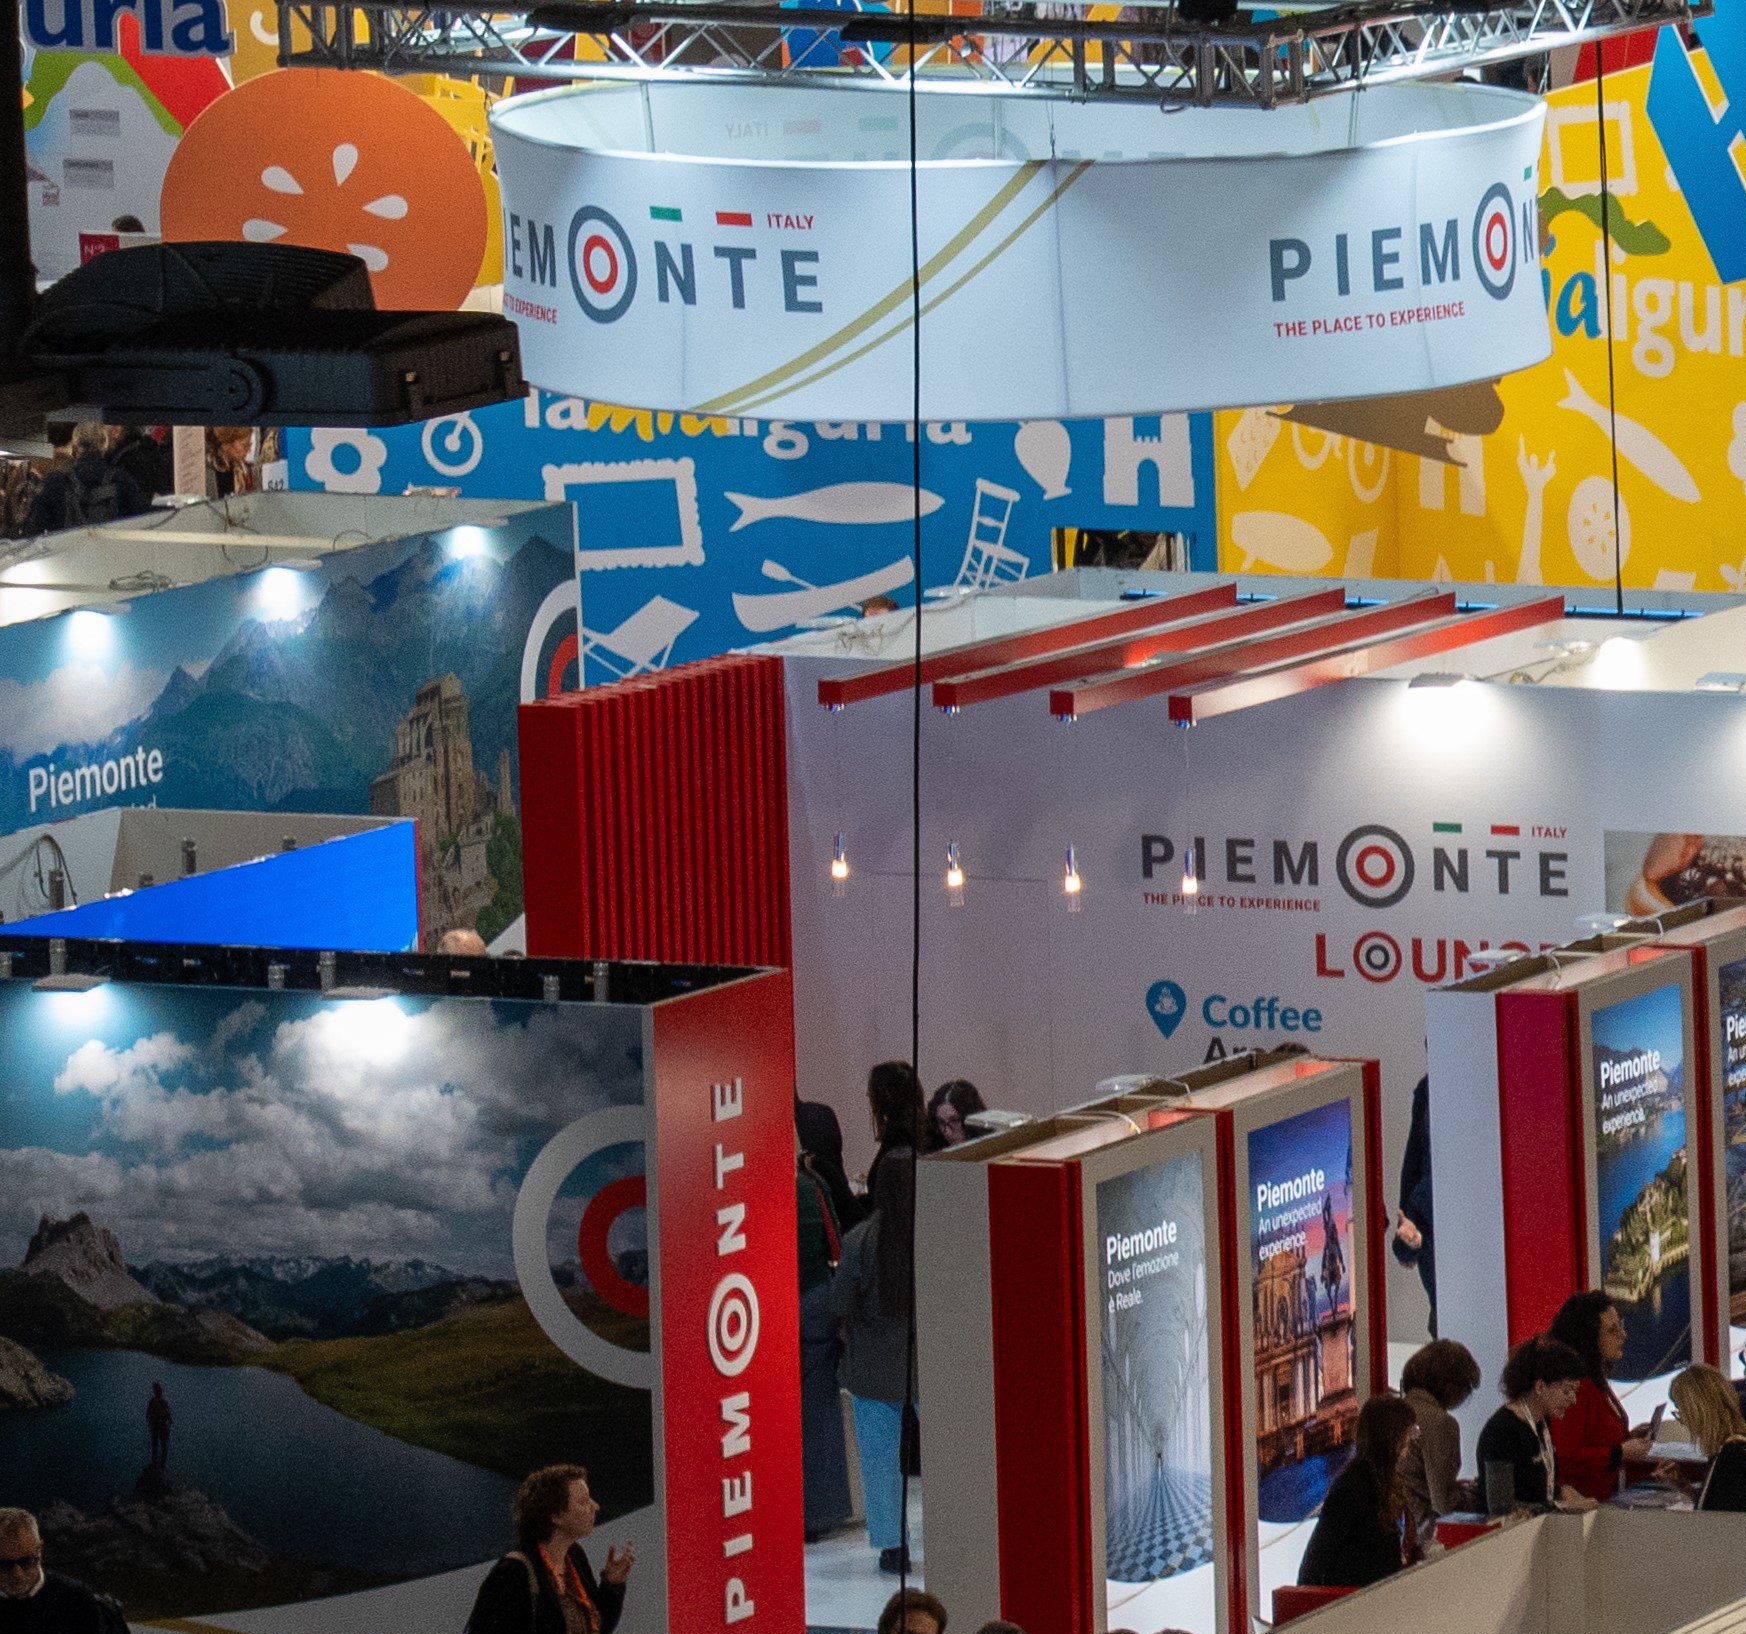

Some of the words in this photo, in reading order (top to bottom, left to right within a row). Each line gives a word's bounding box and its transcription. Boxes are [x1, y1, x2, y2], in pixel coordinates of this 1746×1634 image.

[766, 213, 814, 232] ITALY
[1269, 182, 1535, 302] PIEMON
[504, 205, 823, 324] IEMONTE
[1274, 321, 1308, 338] THE
[1312, 315, 1362, 336] PLACE
[1366, 312, 1386, 329] TO
[1390, 301, 1465, 326] EXPERIENCE
[28, 745, 164, 812] Piemonte
[1530, 825, 1568, 840] ITALY
[1142, 824, 1570, 909] PIEMONTE
[1143, 891, 1168, 905] THE
[1219, 895, 1235, 908] TO
[1240, 896, 1321, 911] EXPERIENCE
[1202, 994, 1323, 1032] Coffee
[1600, 1048, 1661, 1089] Piemonte
[1258, 1168, 1325, 1213] Piemonte
[1259, 1218, 1272, 1236] An
[1273, 1196, 1323, 1228] unexpected
[1106, 1219, 1177, 1265] Piemonte
[1108, 1267, 1131, 1289] Dove
[707, 1077, 760, 1625] PIEMONTE
